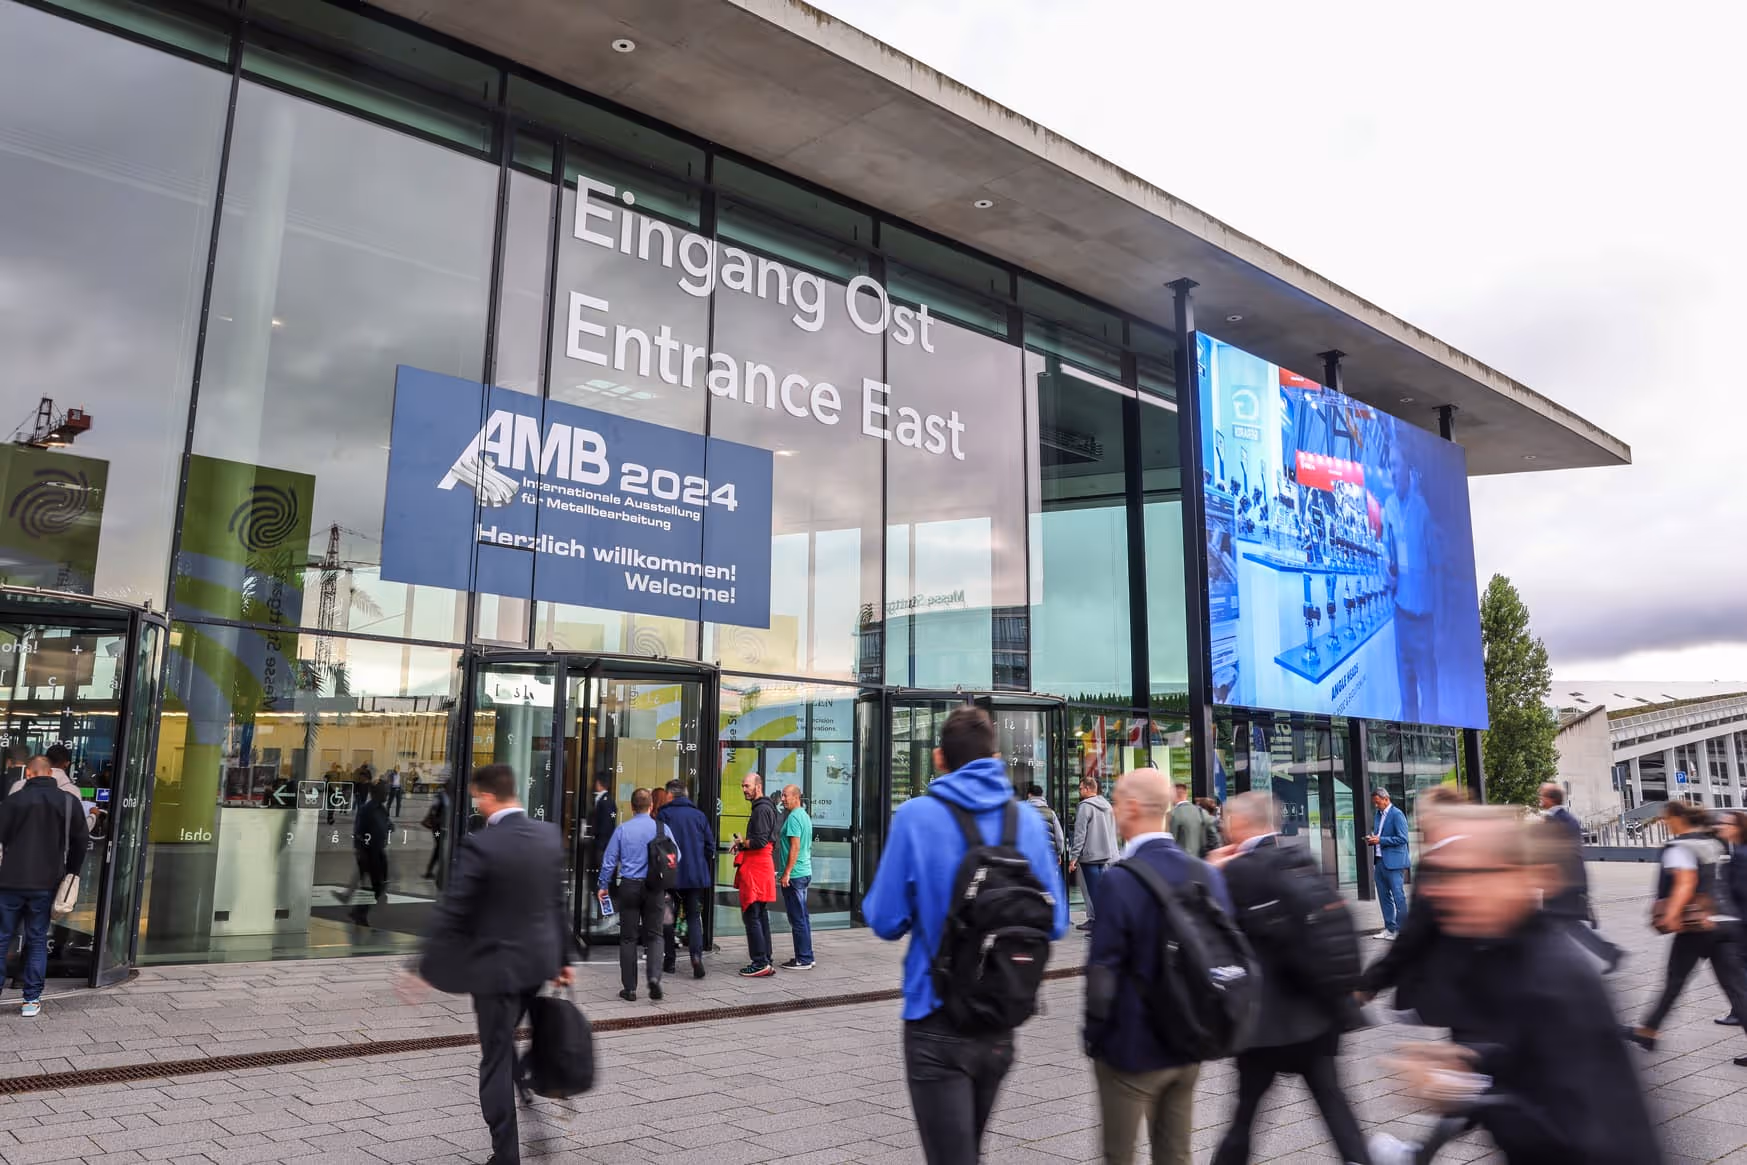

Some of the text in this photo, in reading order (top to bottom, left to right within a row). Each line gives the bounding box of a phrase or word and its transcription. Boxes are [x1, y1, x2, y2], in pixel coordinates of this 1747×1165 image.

[574, 174, 935, 353] Eingang Ost
[566, 291, 965, 460] Entrance East
[437, 409, 738, 512] AMB 2024
[521, 492, 672, 531] für Metallbearbeitung
[522, 477, 701, 522] Internationale Ausstellung
[476, 523, 736, 582] Herzlich willkommen!
[624, 571, 736, 604] Welcome!
